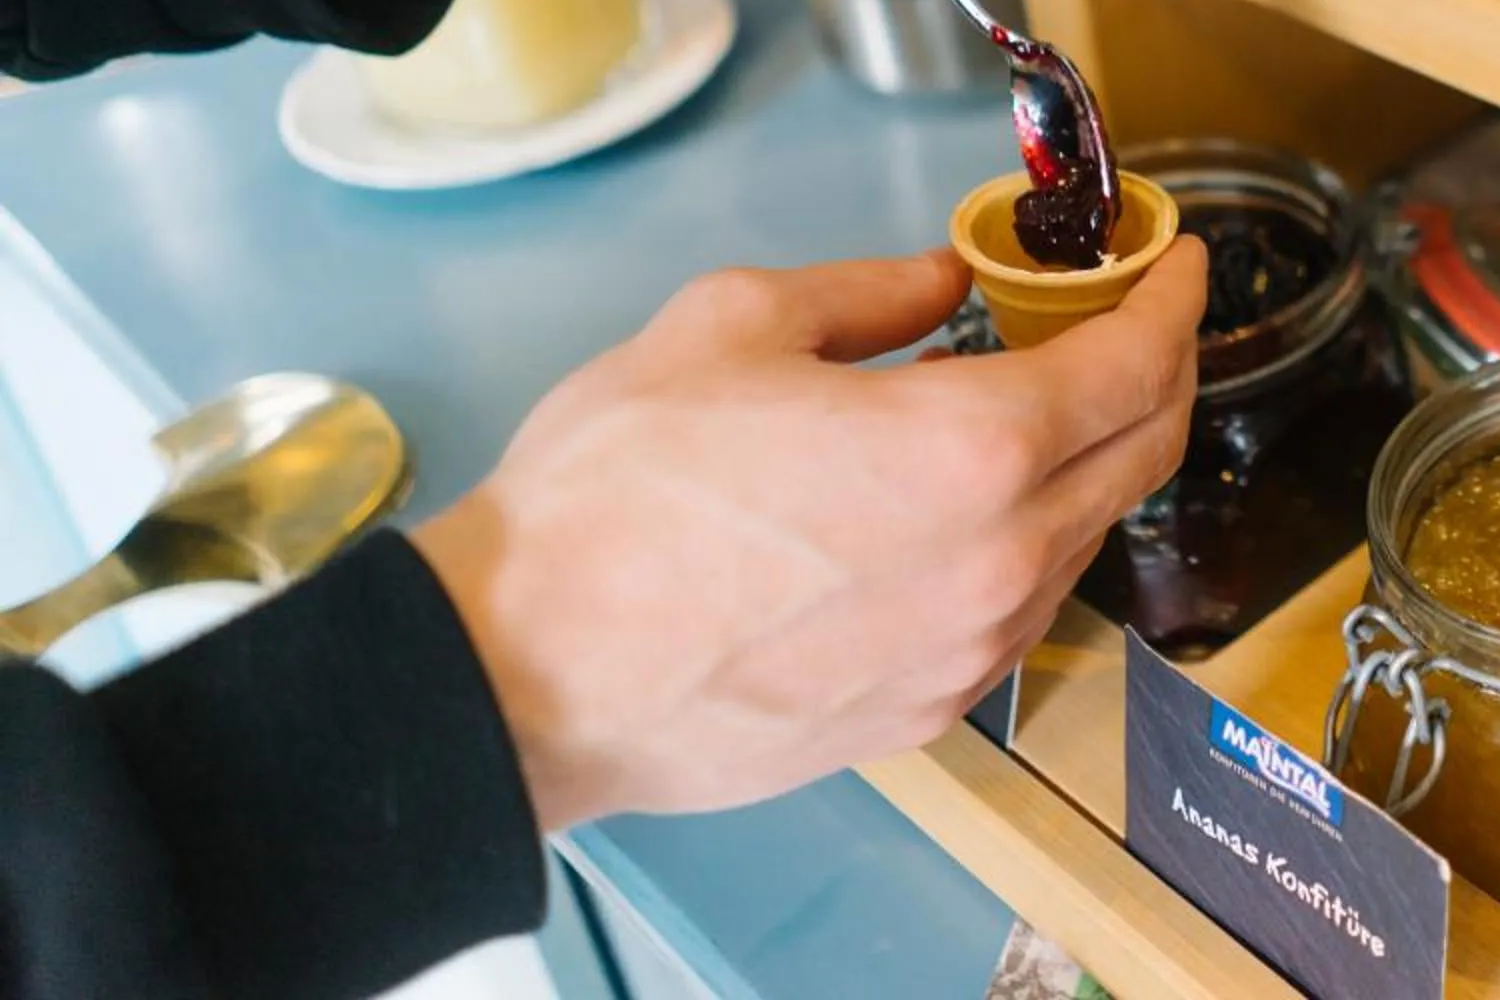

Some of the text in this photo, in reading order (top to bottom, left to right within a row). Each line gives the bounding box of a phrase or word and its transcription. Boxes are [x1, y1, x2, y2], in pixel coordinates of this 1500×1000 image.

[1222, 719, 1331, 819] MAINTAL
[1172, 787, 1386, 958] Ananas Konfitüre
